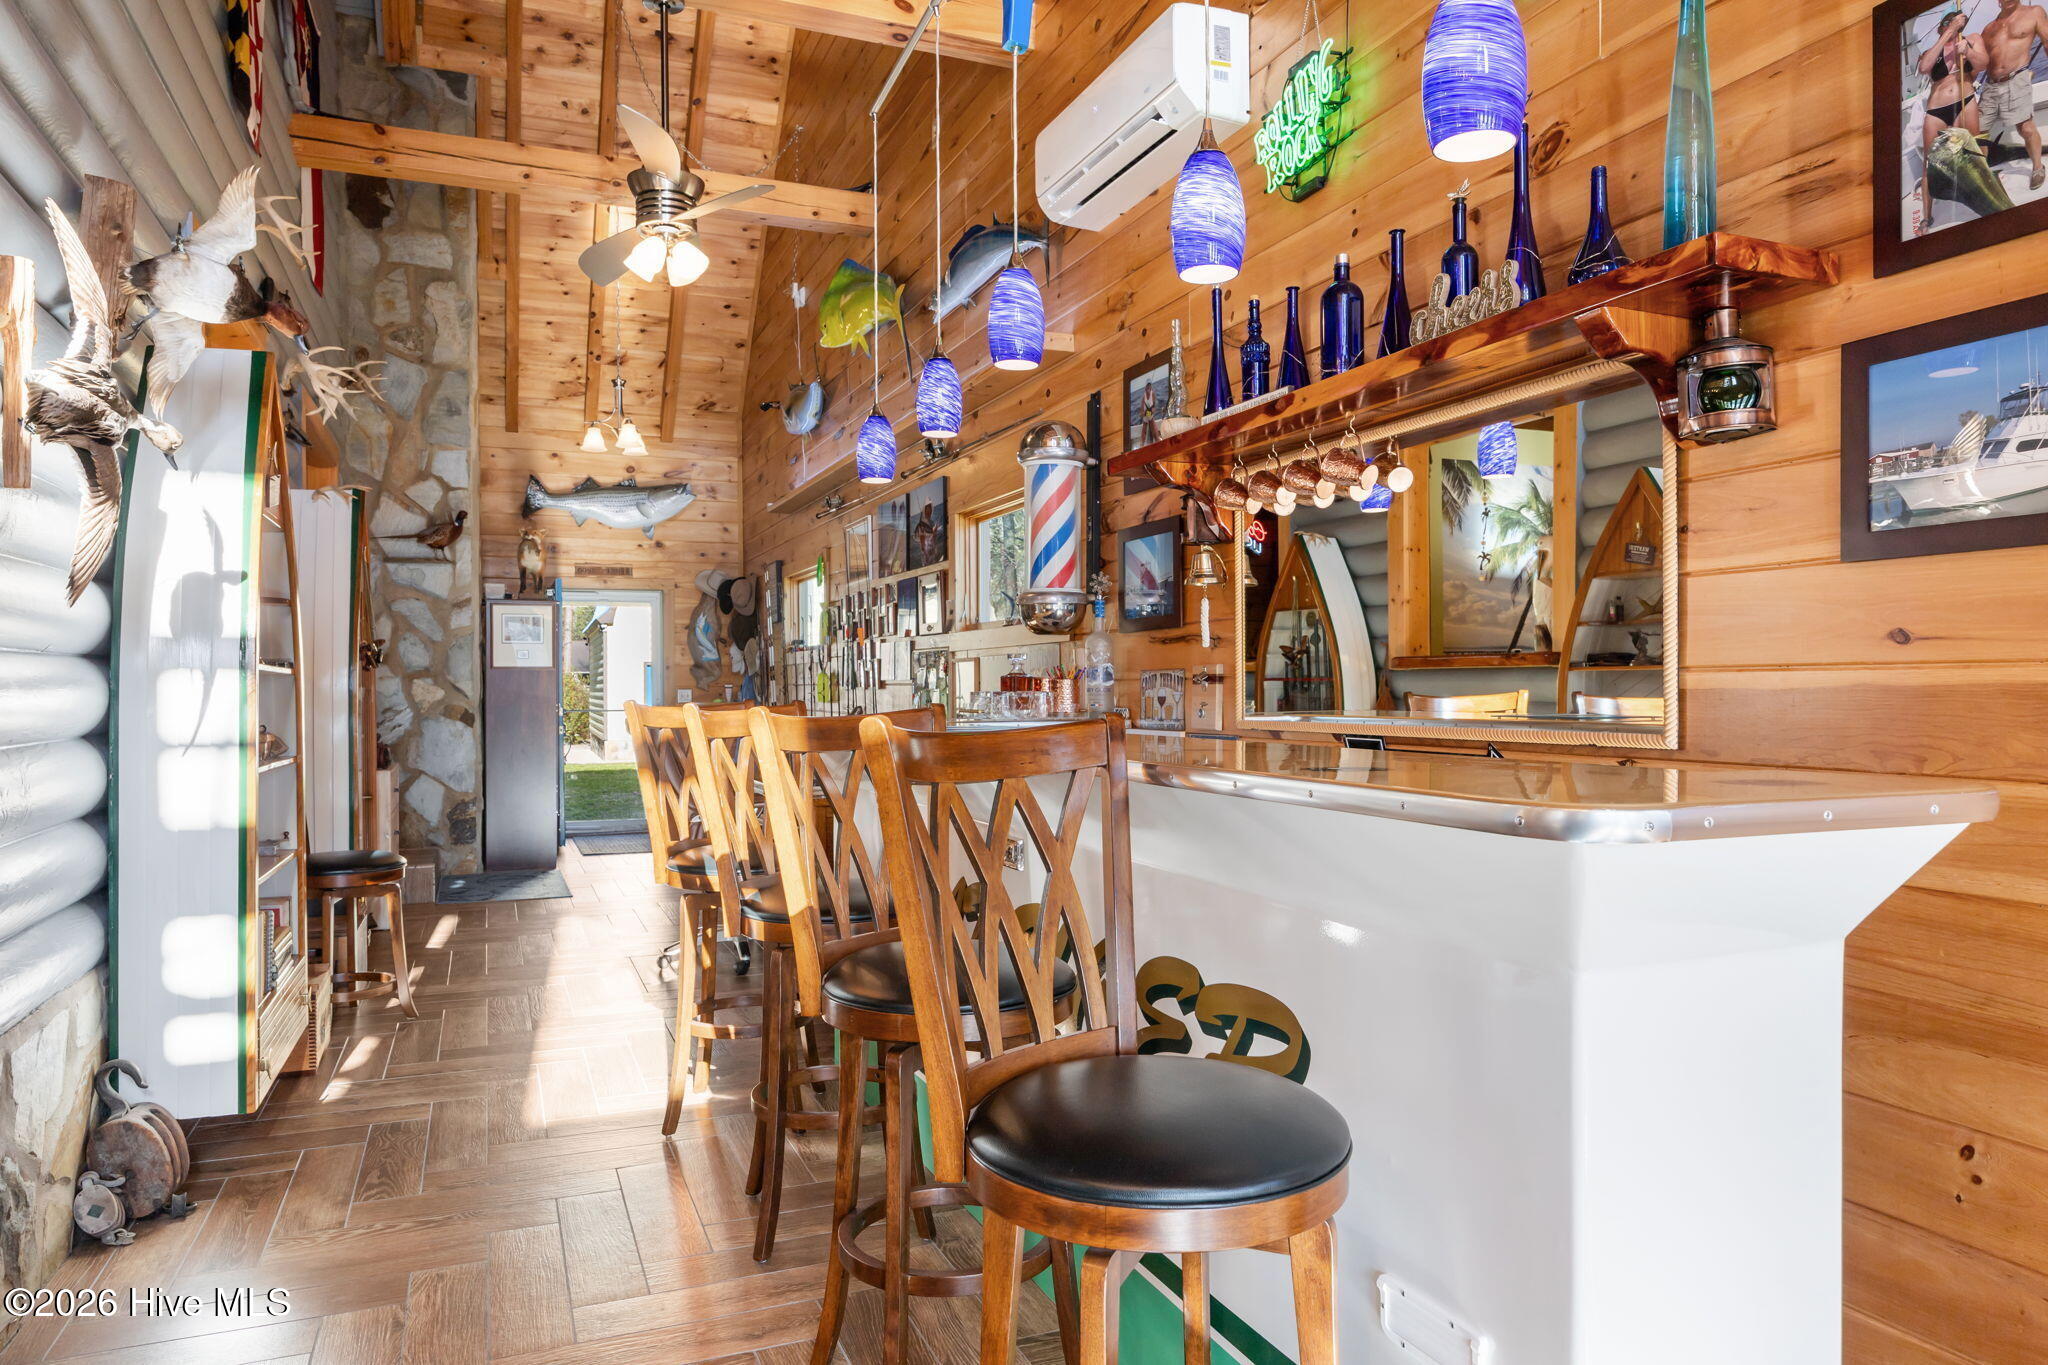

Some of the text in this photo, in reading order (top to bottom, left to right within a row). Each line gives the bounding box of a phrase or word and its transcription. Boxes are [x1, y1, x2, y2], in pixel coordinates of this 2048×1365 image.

[1254, 38, 1334, 165] ROLLING
[1264, 108, 1322, 194] ROCK
[1409, 259, 1520, 347] cheers
